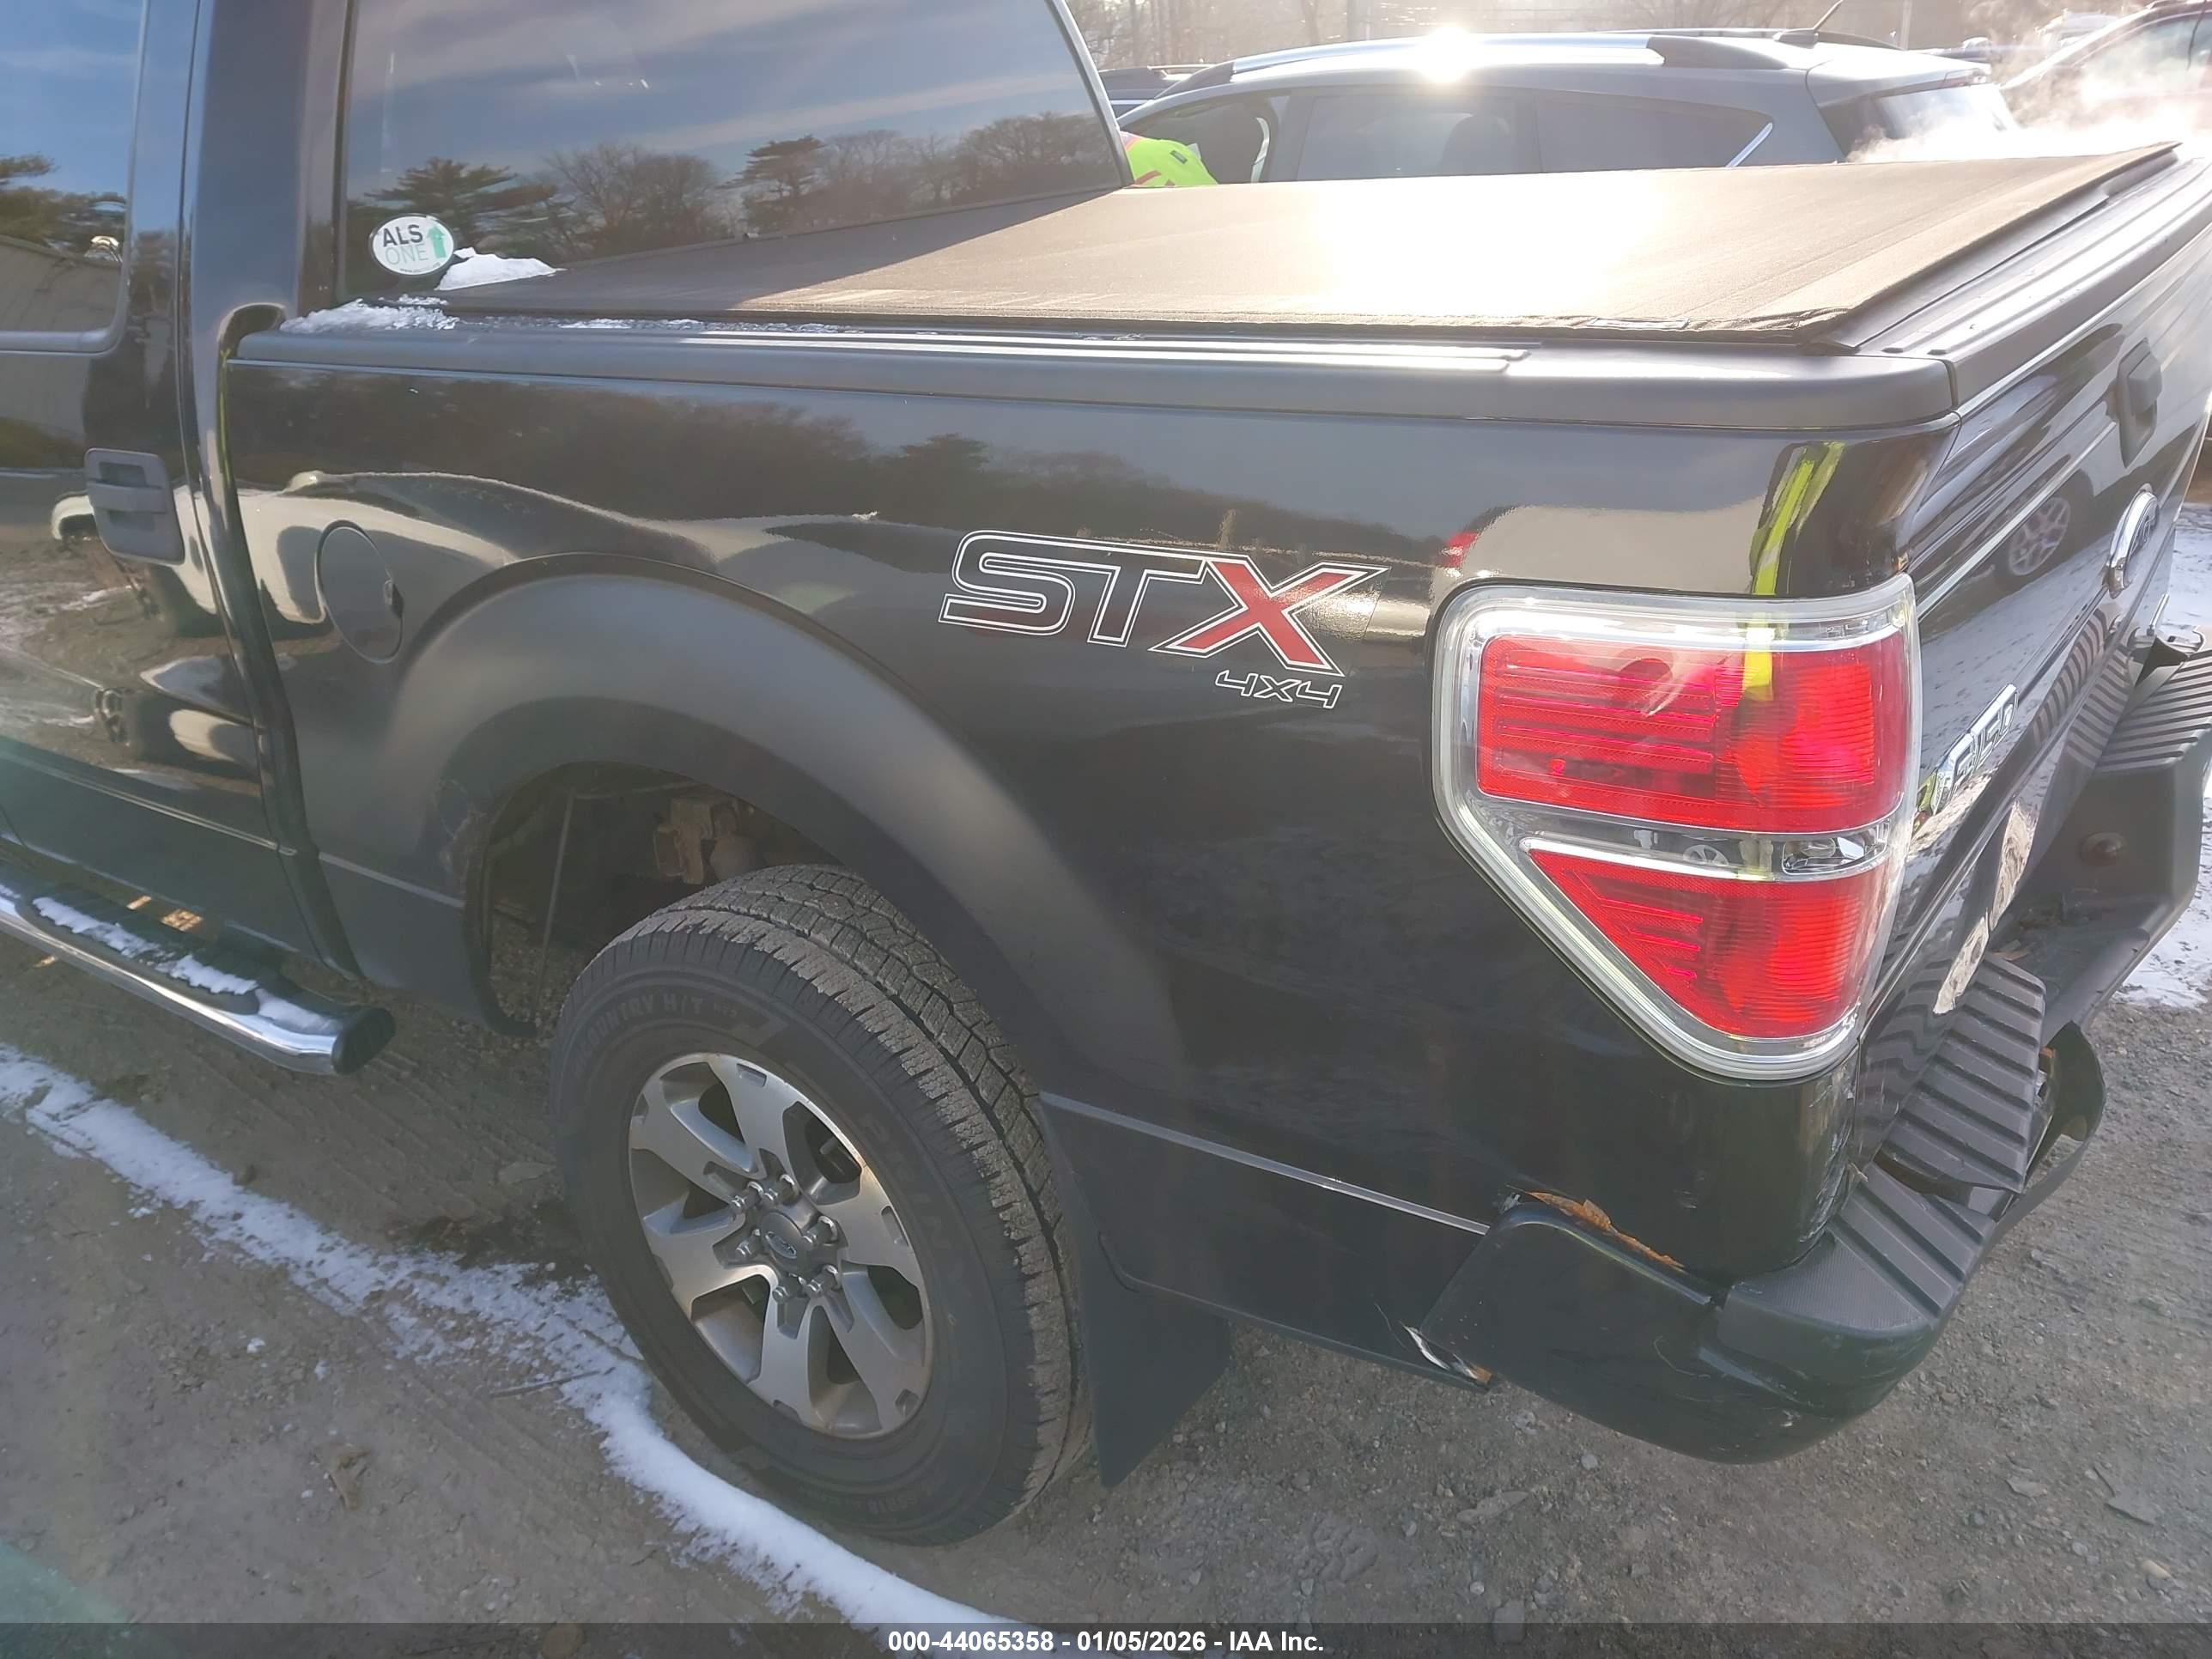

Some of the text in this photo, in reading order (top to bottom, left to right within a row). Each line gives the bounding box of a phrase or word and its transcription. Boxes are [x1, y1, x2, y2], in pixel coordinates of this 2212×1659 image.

[382, 224, 423, 247] ALS
[386, 243, 428, 265] ONE
[938, 530, 1392, 677] STX
